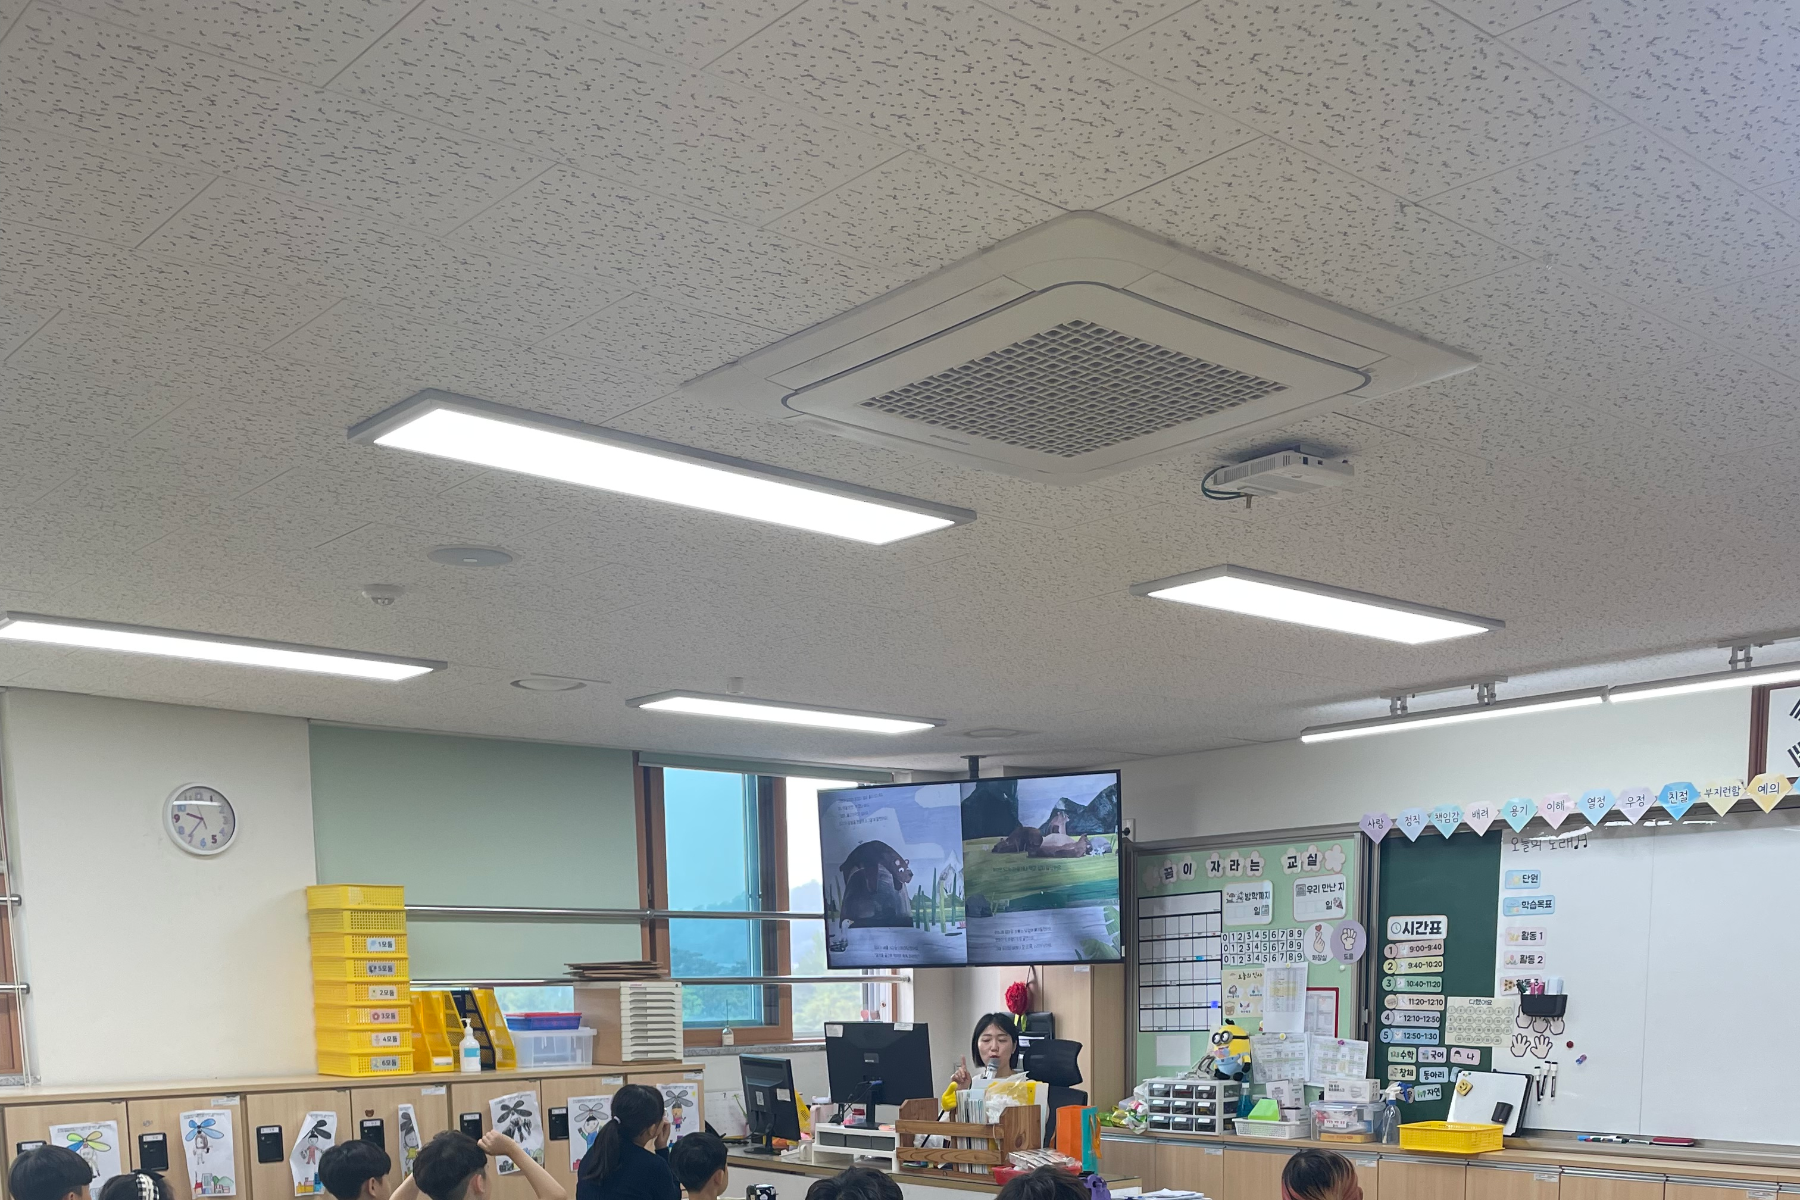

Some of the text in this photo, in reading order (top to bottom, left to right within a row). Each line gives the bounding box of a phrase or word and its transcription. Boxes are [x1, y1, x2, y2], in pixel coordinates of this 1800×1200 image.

[1704, 786, 1740, 798] 부지런함
[1758, 782, 1780, 795] 예의
[1587, 796, 1605, 809] 열정
[1626, 794, 1645, 807] 우정
[1668, 790, 1688, 804] 친절
[1510, 804, 1528, 818] 용기
[1547, 800, 1565, 811] 이해
[1404, 814, 1420, 826] 정직
[1434, 811, 1460, 824] 책임감
[1472, 809, 1489, 820] 배려
[1367, 819, 1384, 829] 사랑
[1511, 837, 1542, 852] 오늘의
[1210, 859, 1260, 873] 자라는
[1287, 853, 1318, 869] 교실
[1522, 874, 1538, 884] 단원
[1306, 882, 1344, 894] 우리 만난 지
[1244, 891, 1270, 901] 방학까지
[1326, 900, 1332, 910] 일
[1521, 900, 1552, 910] 학습목표
[1402, 920, 1442, 935] 시간표
[1521, 931, 1537, 941] 활동
[1409, 944, 1442, 952] 9:00-9:40
[1520, 954, 1535, 964] 활동
[1400, 1050, 1414, 1060] 수학
[1430, 1051, 1444, 1059] 국어
[1423, 1071, 1445, 1080] 동아리
[1427, 1088, 1440, 1096] 자연
